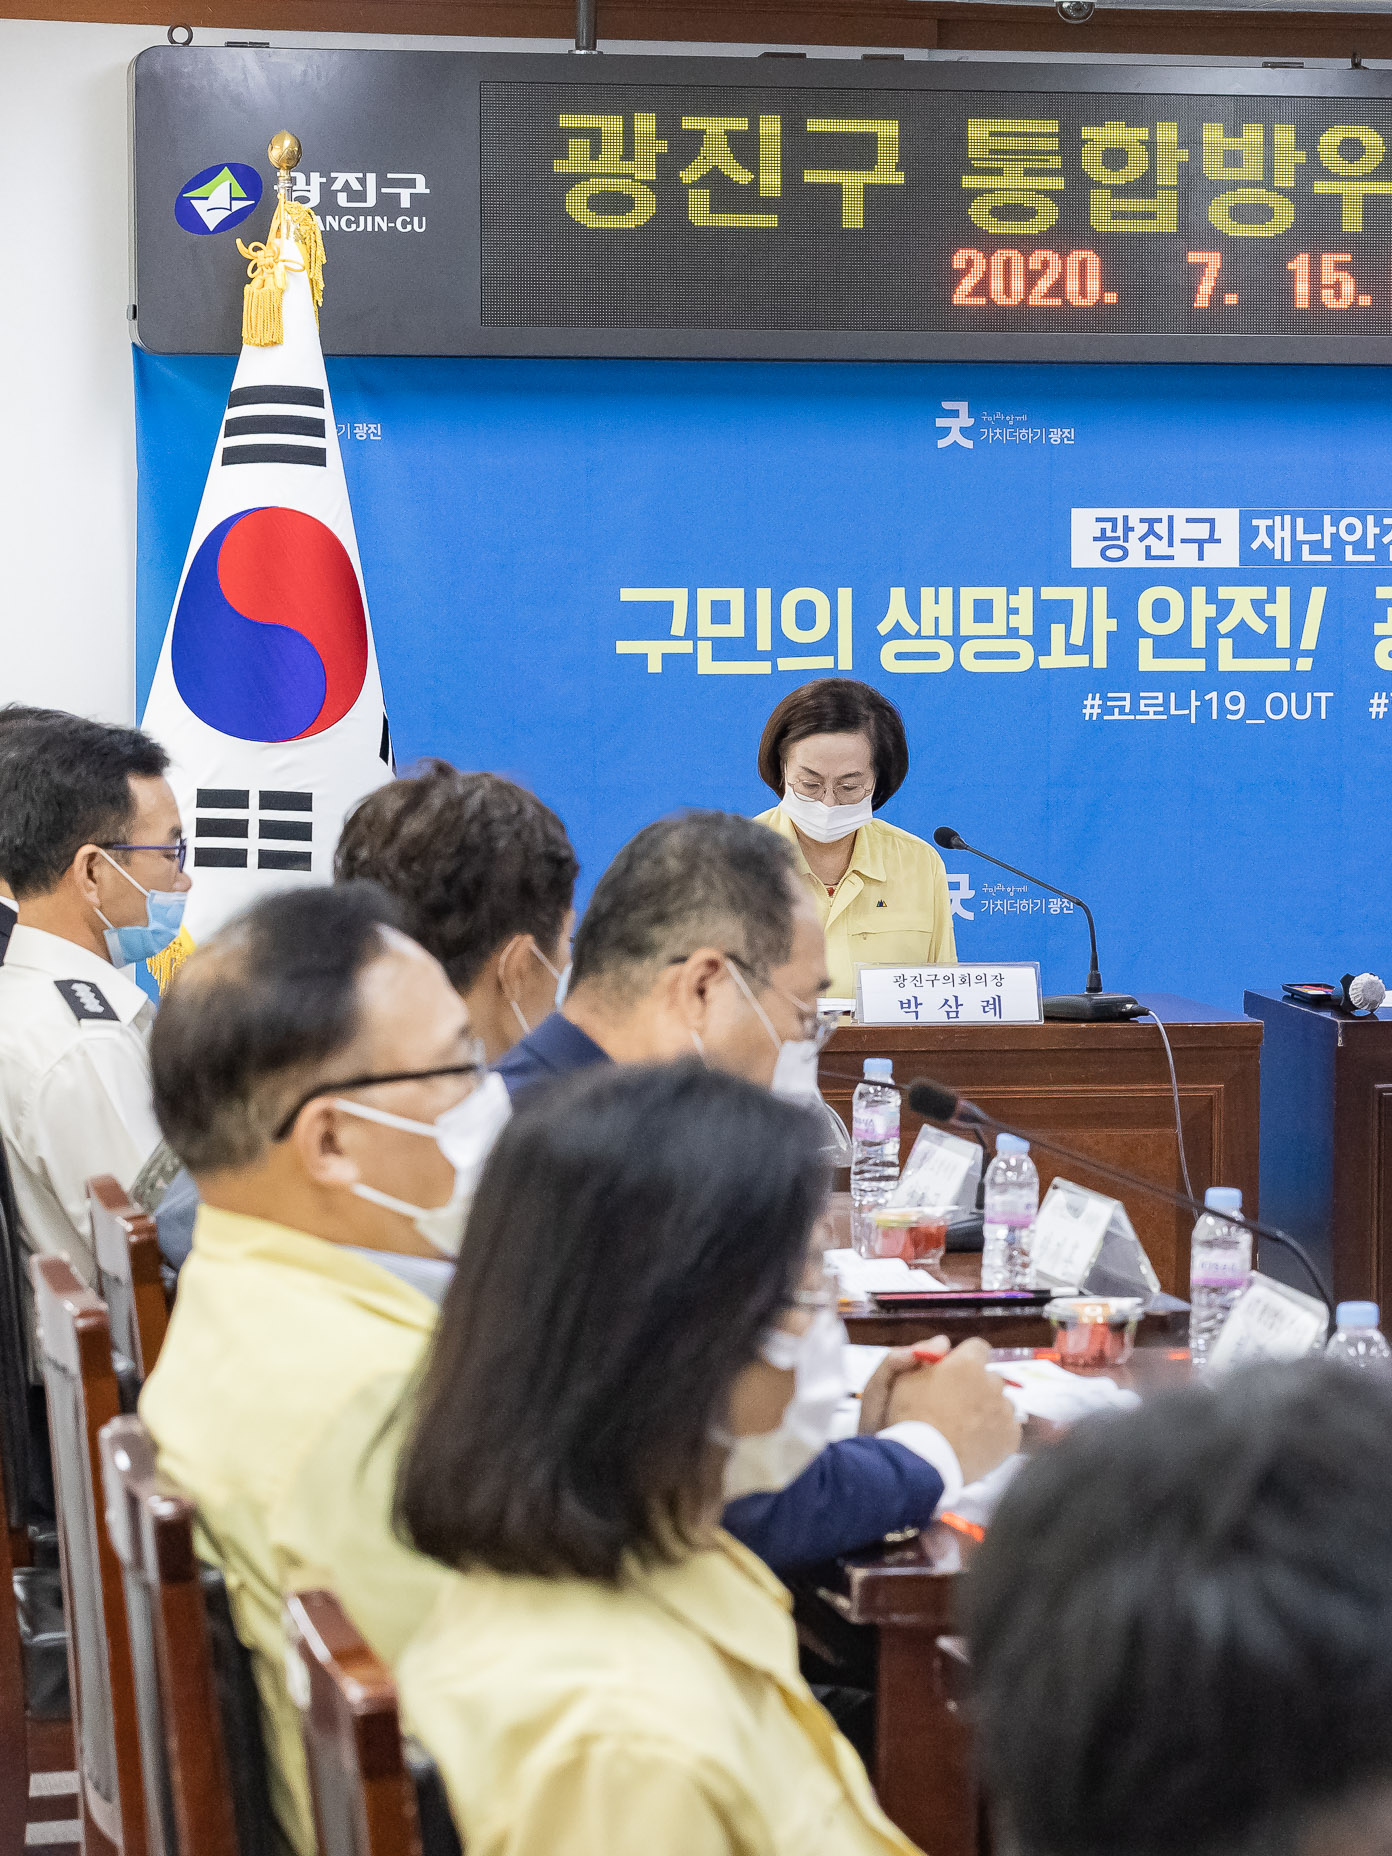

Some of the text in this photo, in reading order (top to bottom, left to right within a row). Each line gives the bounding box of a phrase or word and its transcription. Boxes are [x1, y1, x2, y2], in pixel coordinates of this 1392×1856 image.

[274, 171, 431, 209] 광진구
[553, 113, 905, 230] 광진구
[951, 248, 1118, 307] 2020.
[1186, 251, 1238, 308] 7.
[353, 423, 382, 441] 광진
[979, 427, 1075, 445] 가치더하기 광진
[1091, 514, 1223, 562] 광진구
[615, 586, 854, 676] 구민의
[876, 585, 1118, 674] 생명과
[1137, 585, 1328, 673] 안전!
[1082, 689, 1335, 726] #코로나19_OUT
[980, 898, 1074, 915] 가치더하기 광진
[892, 972, 1006, 989] 광진구의회의장
